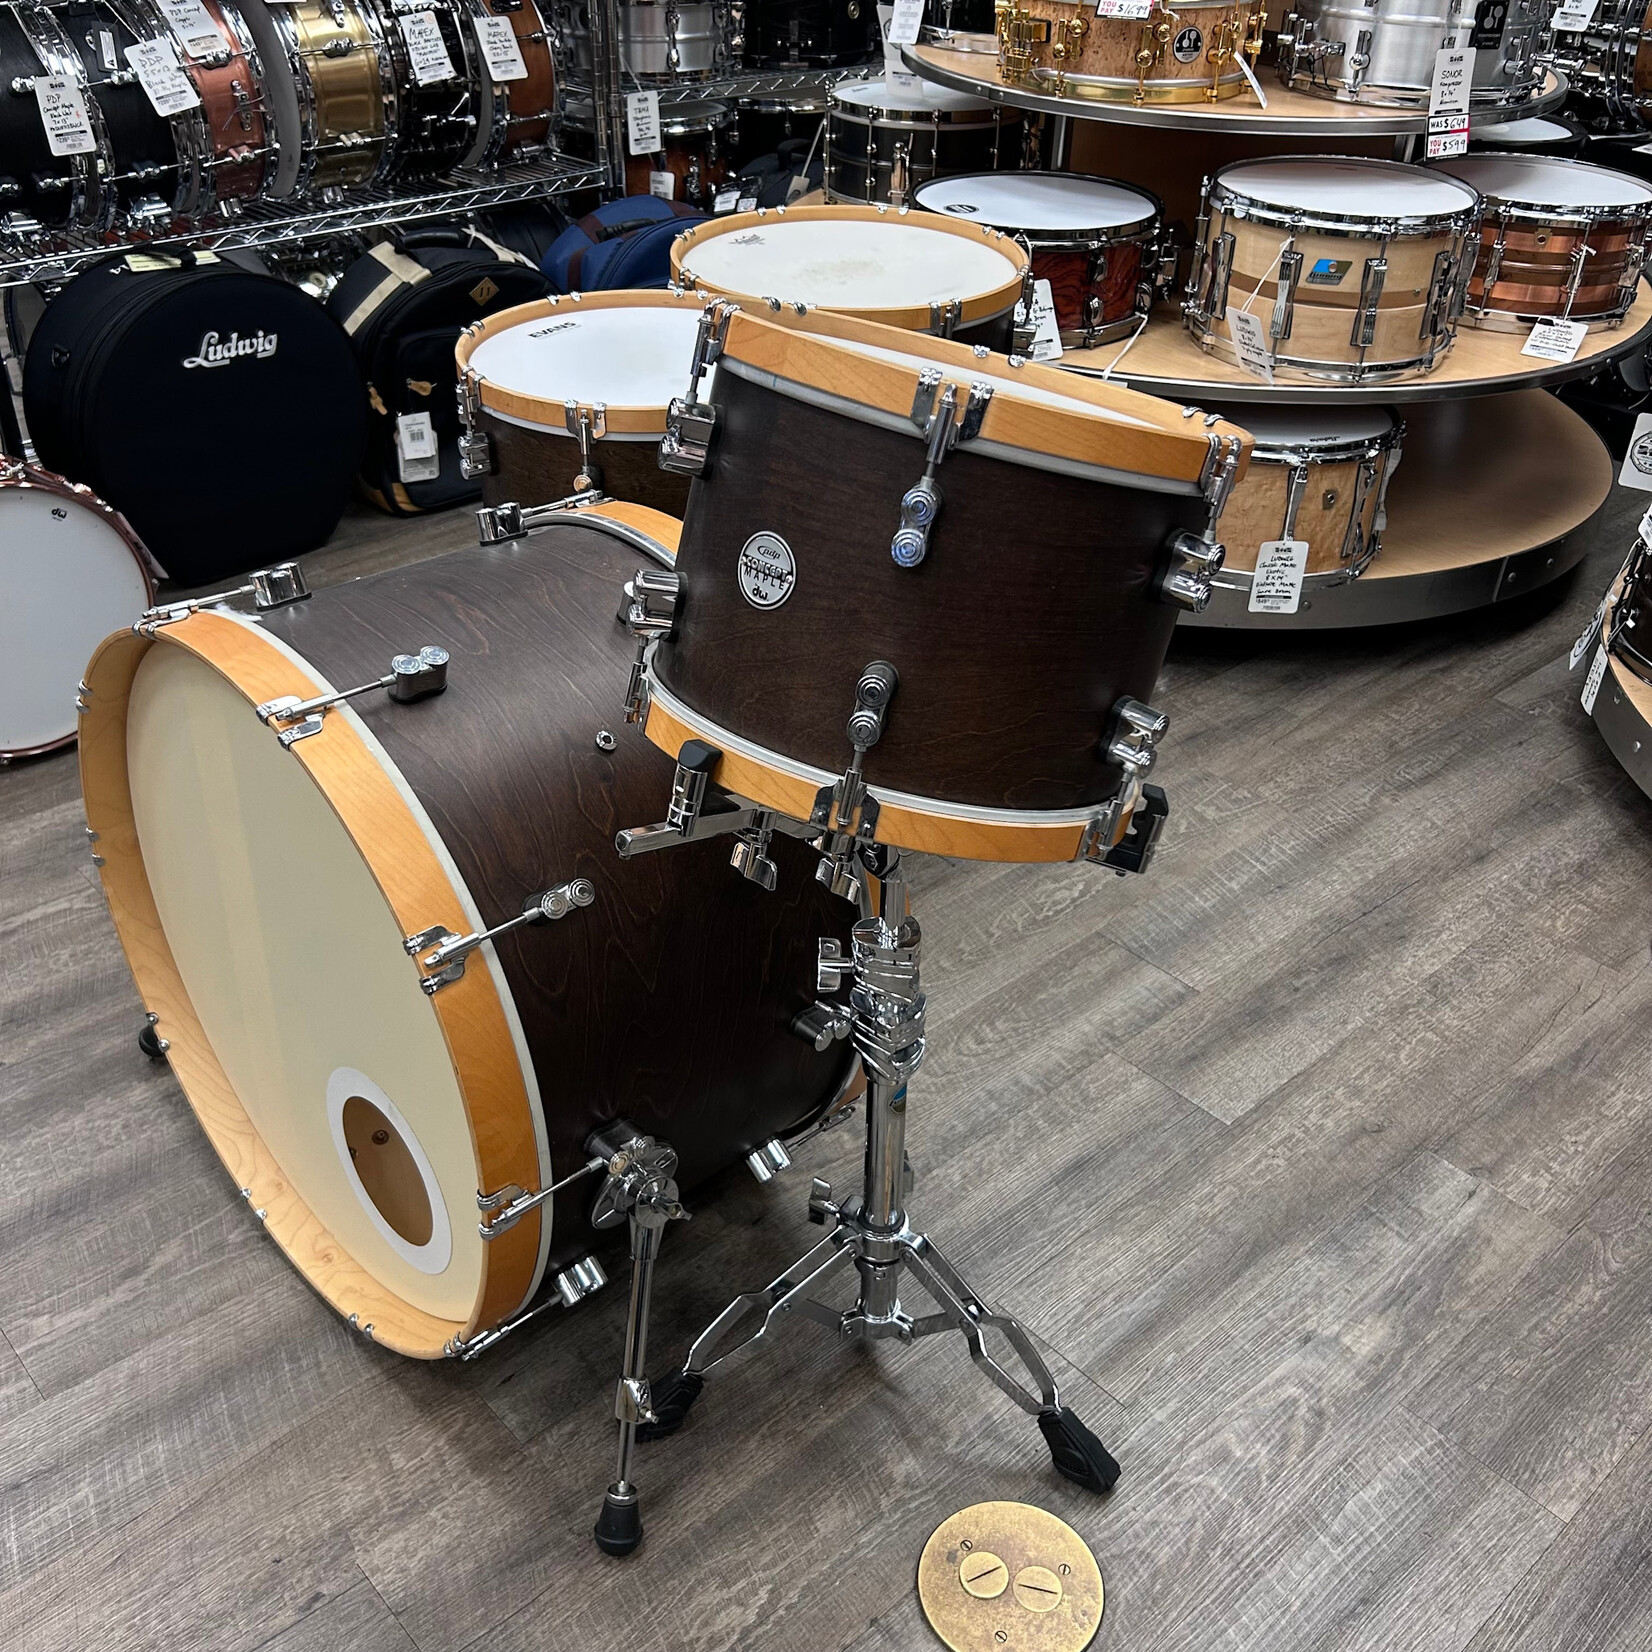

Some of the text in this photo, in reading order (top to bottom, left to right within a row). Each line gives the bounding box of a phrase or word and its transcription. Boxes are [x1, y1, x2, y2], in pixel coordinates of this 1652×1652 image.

[1118, 4, 1148, 15] $1699
[409, 28, 434, 40] MAPEX
[138, 56, 163, 68] PDP
[1441, 69, 1462, 80] SONOR
[46, 94, 61, 104] PDP
[1430, 118, 1466, 129] WAS $649
[1430, 139, 1441, 147] YOU
[1442, 139, 1466, 152] $599
[528, 322, 576, 338] EVANS
[183, 330, 277, 368] Ludwig
[51, 508, 67, 519] dw
[746, 556, 788, 580] CONCEPT
[744, 567, 784, 590] MAPLE
[752, 583, 768, 600] dw
